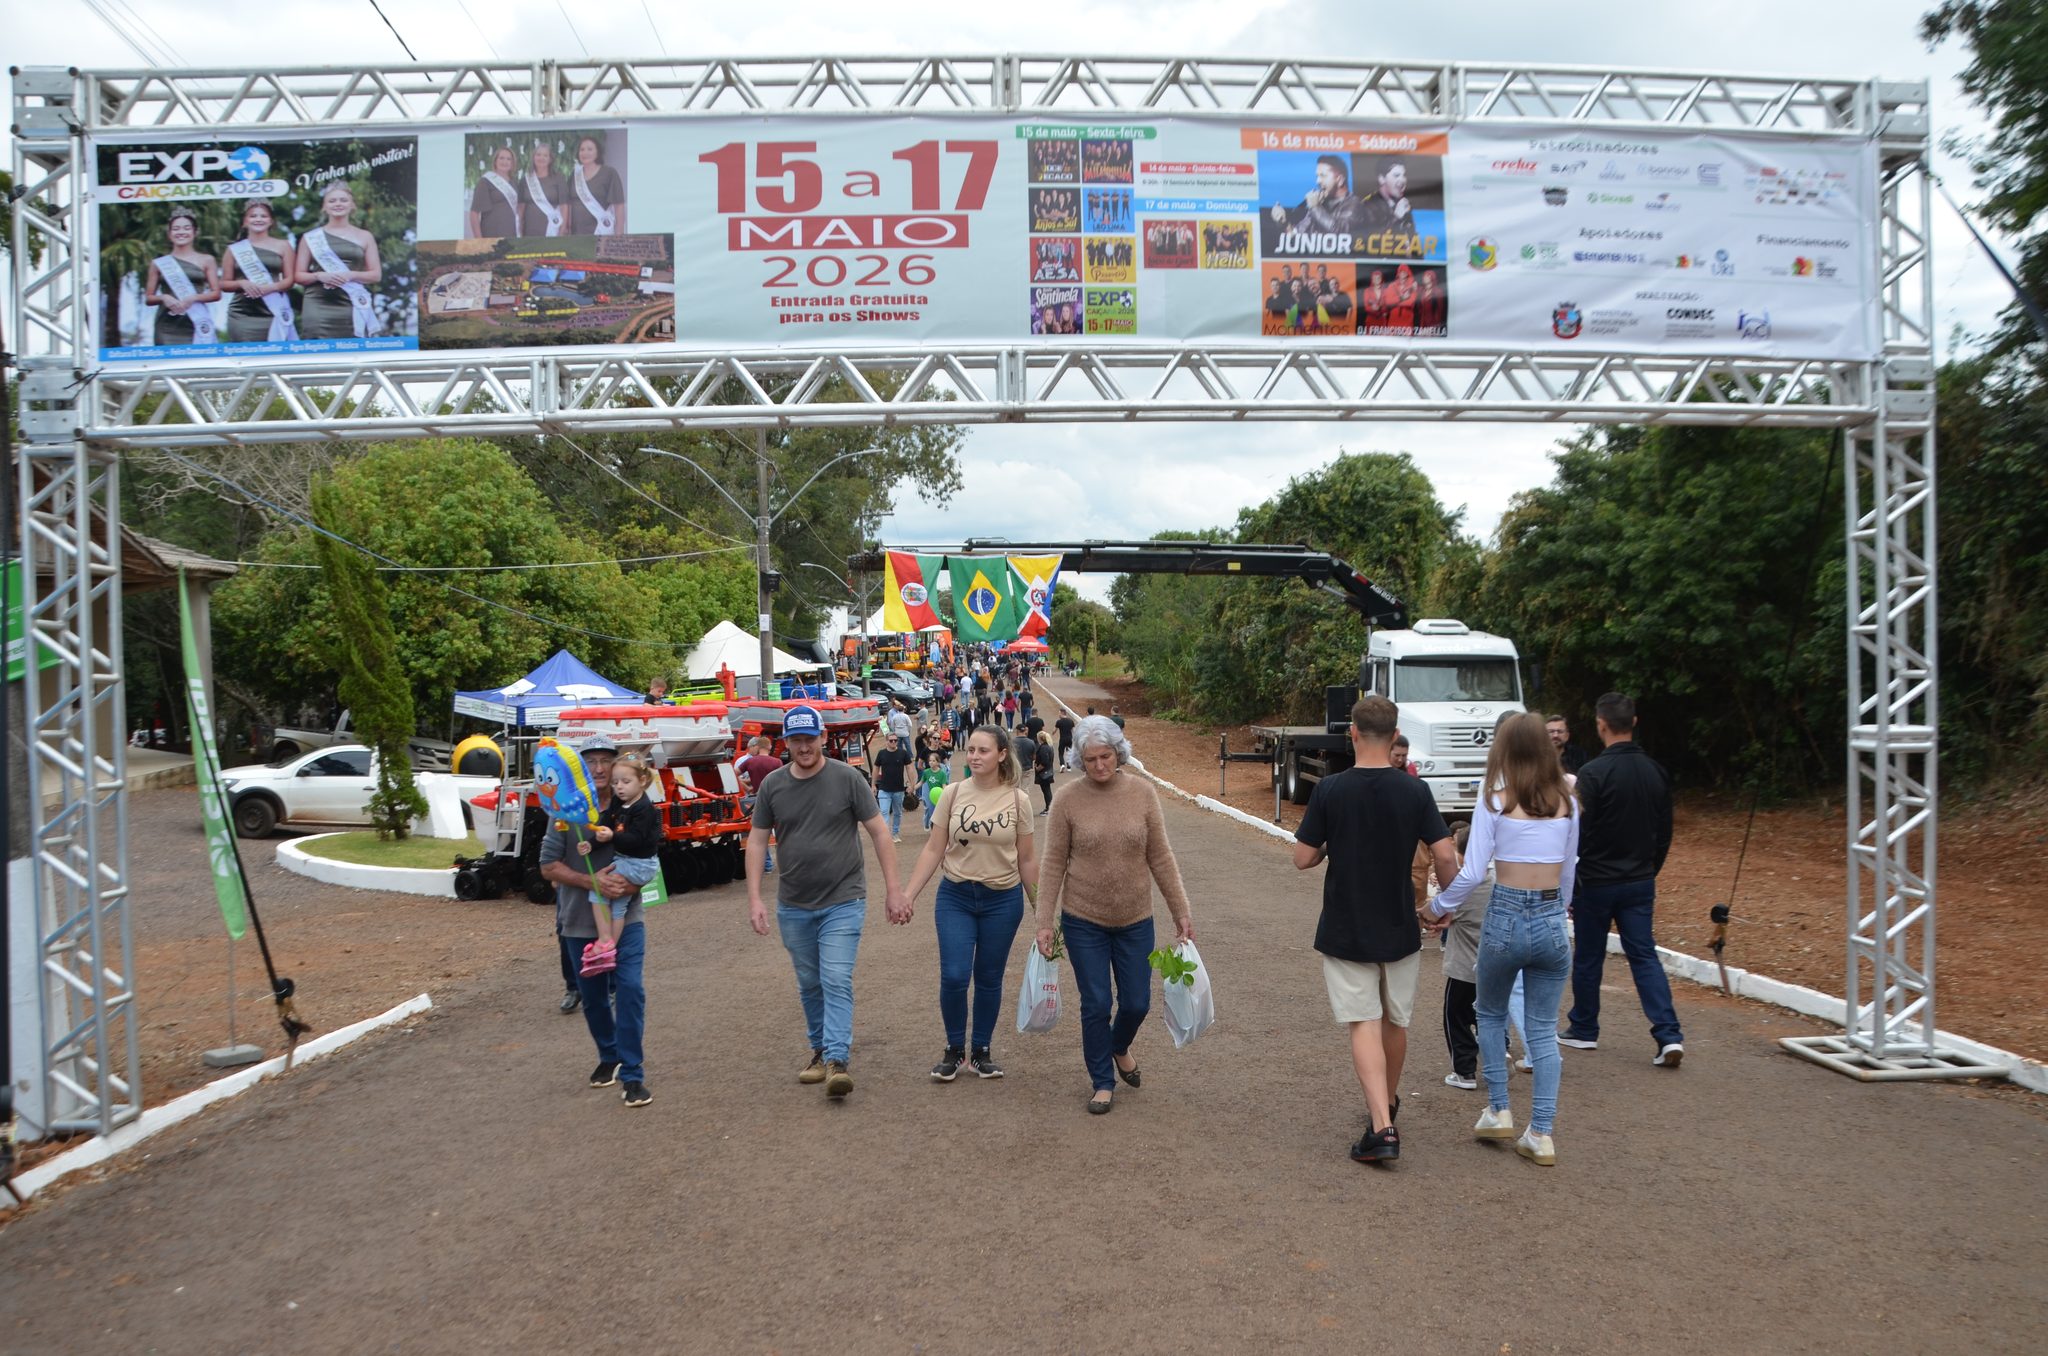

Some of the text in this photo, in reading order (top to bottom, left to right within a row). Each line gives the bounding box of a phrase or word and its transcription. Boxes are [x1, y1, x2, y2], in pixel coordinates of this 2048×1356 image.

[1022, 126, 1031, 137] 15
[1036, 126, 1049, 137] de
[1051, 127, 1077, 138] maio
[1087, 127, 1145, 138] Sexta-feira
[1262, 132, 1279, 147] 16
[1282, 132, 1302, 148] de
[1305, 134, 1344, 149] maio
[1359, 134, 1418, 151] Sábado
[1528, 138, 1659, 155] Patrocinadores
[296, 165, 346, 190] Venha
[348, 158, 370, 174] nos
[1158, 164, 1168, 172] de
[1168, 164, 1187, 172] maio
[698, 140, 998, 213] 15 a 17
[219, 179, 275, 195] 2026
[1145, 200, 1154, 210] 17
[1157, 200, 1169, 210] de
[1171, 200, 1196, 210] maio
[1206, 201, 1249, 212] Domingo
[740, 216, 956, 248] MAIO
[1579, 227, 1663, 240] Apoiadores
[1275, 230, 1438, 255] JÚNIOR & CÉZAR
[1206, 252, 1248, 269] Hello
[761, 254, 936, 288] 2026
[1034, 268, 1079, 281] AESA
[771, 293, 928, 308] Entrada Gratuita
[1035, 287, 1079, 308] Sentinela
[780, 309, 920, 325] para os Shows
[1087, 318, 1098, 332] 15
[1104, 318, 1113, 332] 17
[1263, 322, 1350, 337] Momentos
[1357, 326, 1368, 336] DJ
[1369, 326, 1412, 337] FRANCISCO
[954, 804, 1010, 843] love
